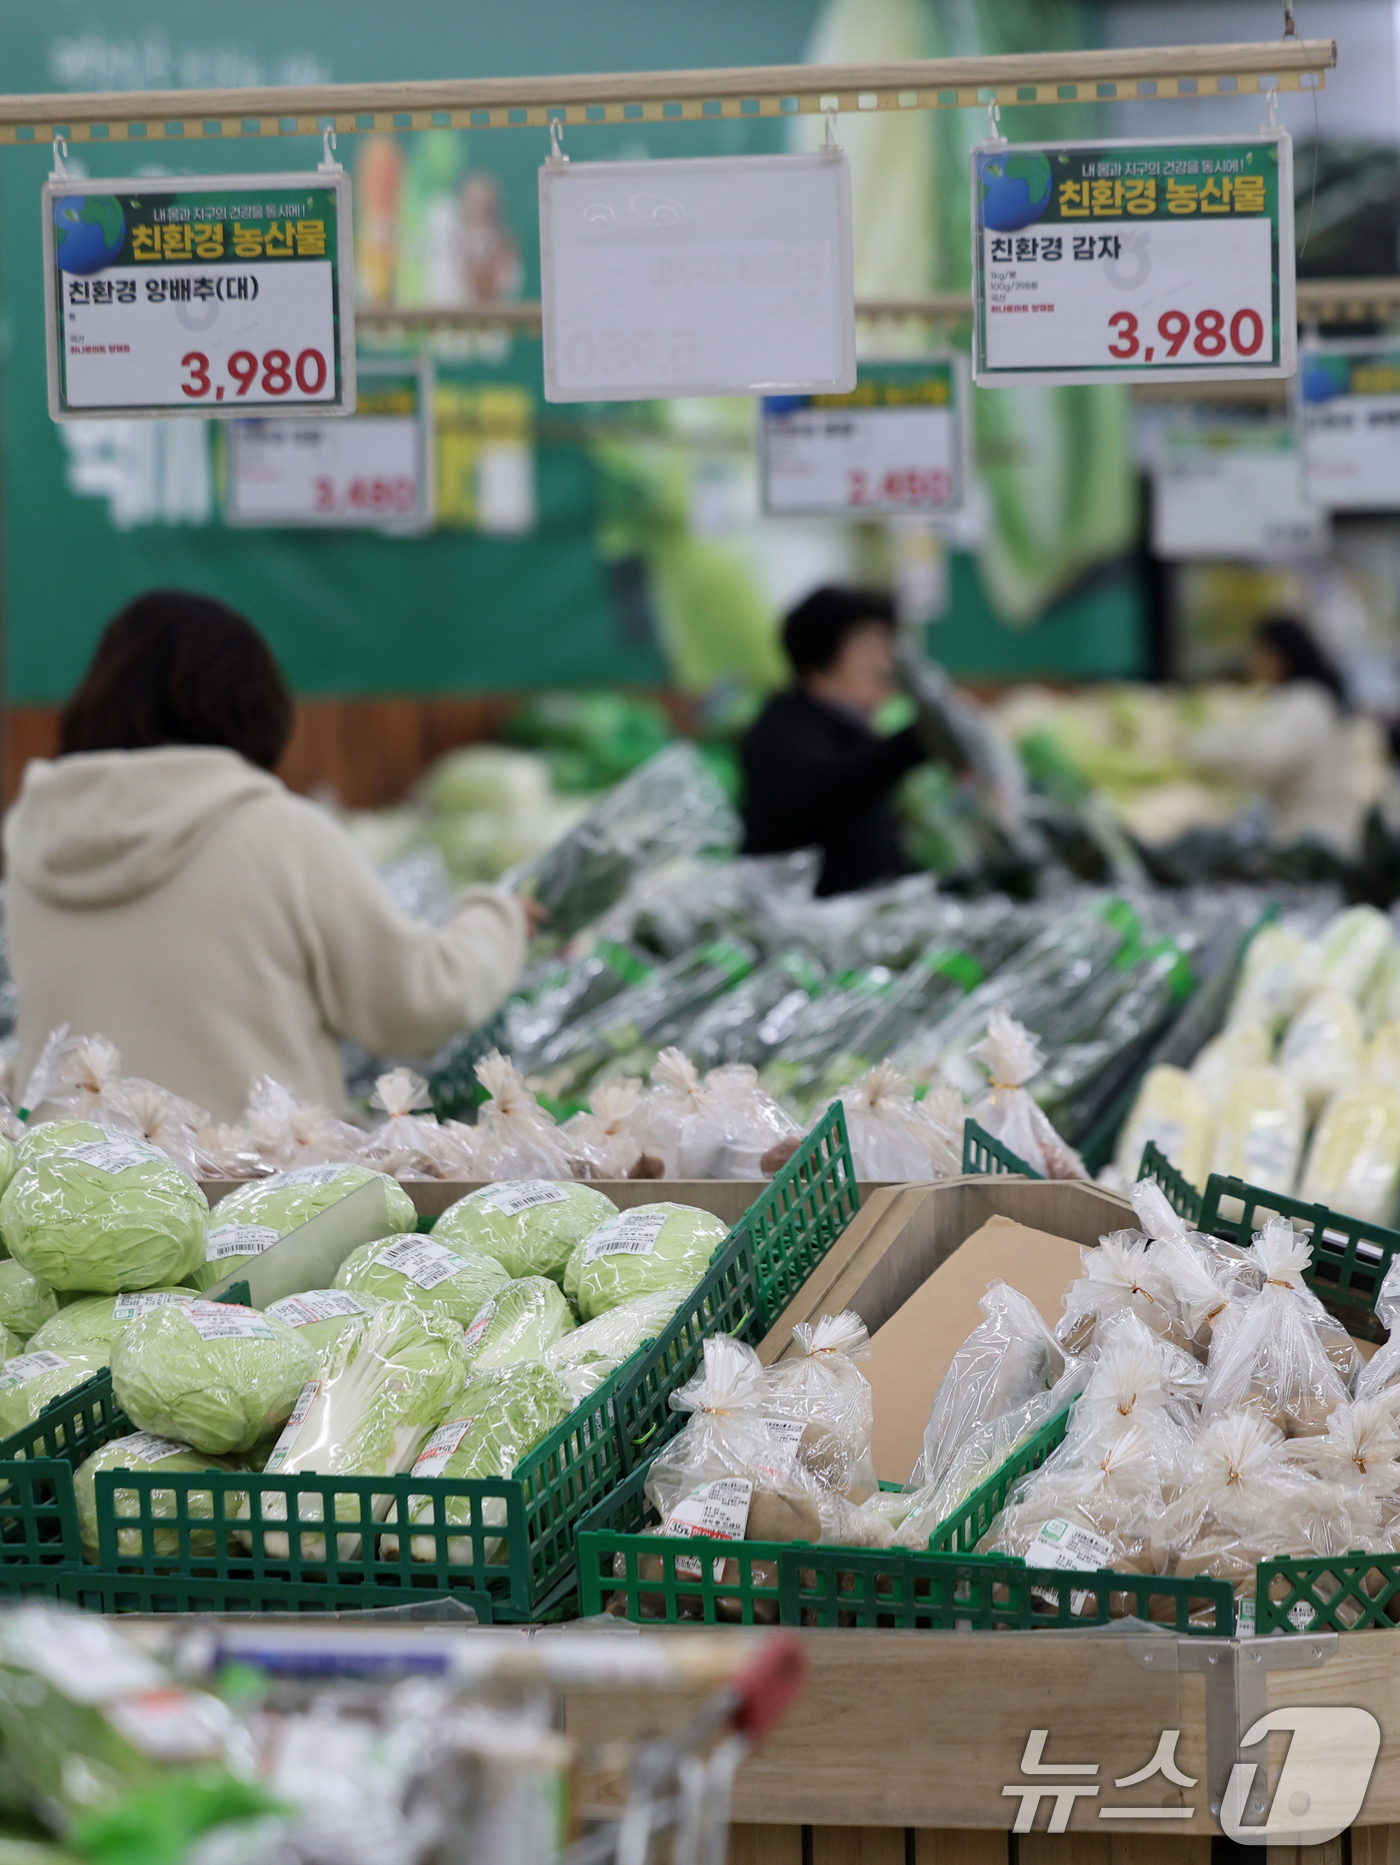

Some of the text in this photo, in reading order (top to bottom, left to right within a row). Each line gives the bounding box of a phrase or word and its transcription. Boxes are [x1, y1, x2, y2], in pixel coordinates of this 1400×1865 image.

[1081, 159, 1245, 178] 내 몸과 지구의 건강을 동시에!
[154, 207, 166, 222] 내
[193, 206, 227, 221] 지구의
[229, 204, 263, 220] 건강을
[1058, 176, 1266, 217] 친환경 농산물
[131, 219, 327, 261] 친환경 농산물
[990, 235, 1122, 263] 친환경 감자
[68, 275, 260, 306] 친환경 양배추(대)
[1107, 308, 1265, 363] 3,980
[180, 348, 328, 402] 3,980
